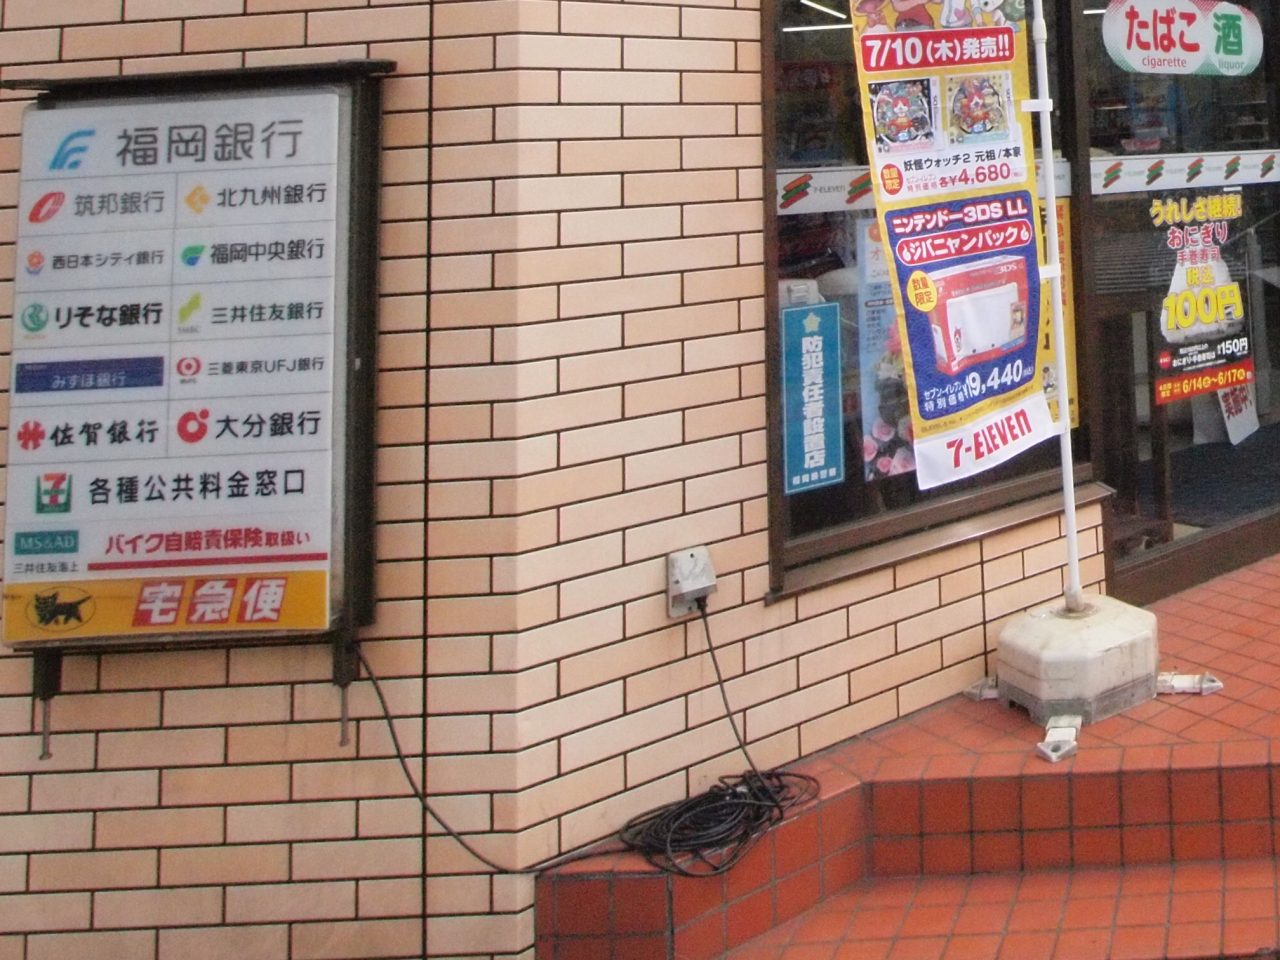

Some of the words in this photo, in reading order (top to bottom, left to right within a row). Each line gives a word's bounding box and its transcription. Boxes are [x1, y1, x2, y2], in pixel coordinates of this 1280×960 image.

[1124, 4, 1201, 53] たばこ
[1212, 10, 1243, 57] 酒
[1141, 56, 1188, 69] cigarette
[1218, 58, 1246, 71] liquor
[116, 118, 303, 168] 福岡銀行
[74, 191, 165, 217] 筑邦銀行
[217, 182, 327, 208] 北九州銀行
[1167, 221, 1228, 249] おにぎり
[52, 249, 164, 270] 西日本シティ銀行
[210, 238, 325, 264] 福岡中央銀行
[55, 302, 163, 329] りそな銀行
[211, 301, 324, 325] 三井住友銀行
[1163, 281, 1245, 331] 100円
[207, 357, 324, 376] 三菱東京UFJ銀行
[50, 419, 159, 447] 佐賀銀行
[215, 410, 322, 439] 大分銀行
[89, 469, 306, 505] 各種公共料金窓口
[136, 578, 286, 625] 宅急便
